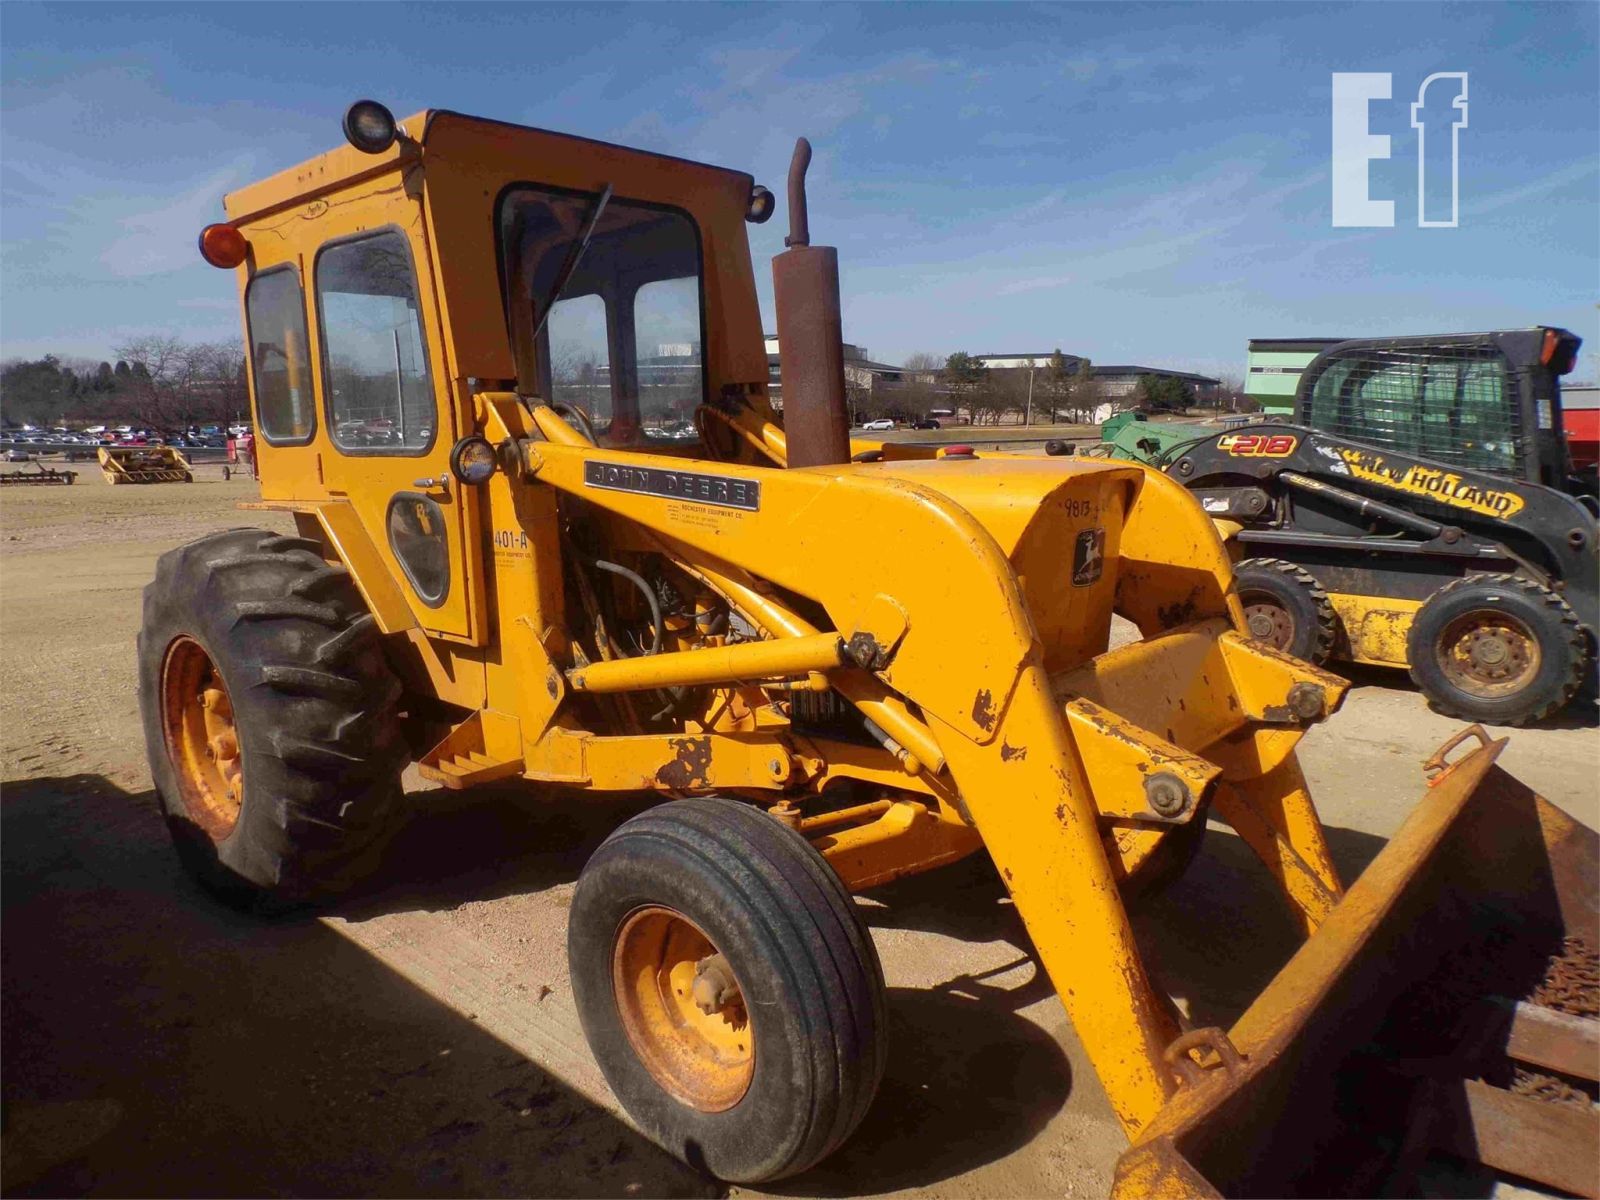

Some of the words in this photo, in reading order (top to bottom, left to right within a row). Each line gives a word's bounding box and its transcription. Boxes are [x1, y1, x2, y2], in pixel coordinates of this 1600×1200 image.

[1219, 435, 1297, 457] L218
[594, 465, 649, 490] JOHN
[664, 474, 746, 504] DEERE
[1410, 469, 1513, 515] HOLLAND
[707, 508, 734, 518] EQUIPMENT
[494, 530, 528, 549] 401-A
